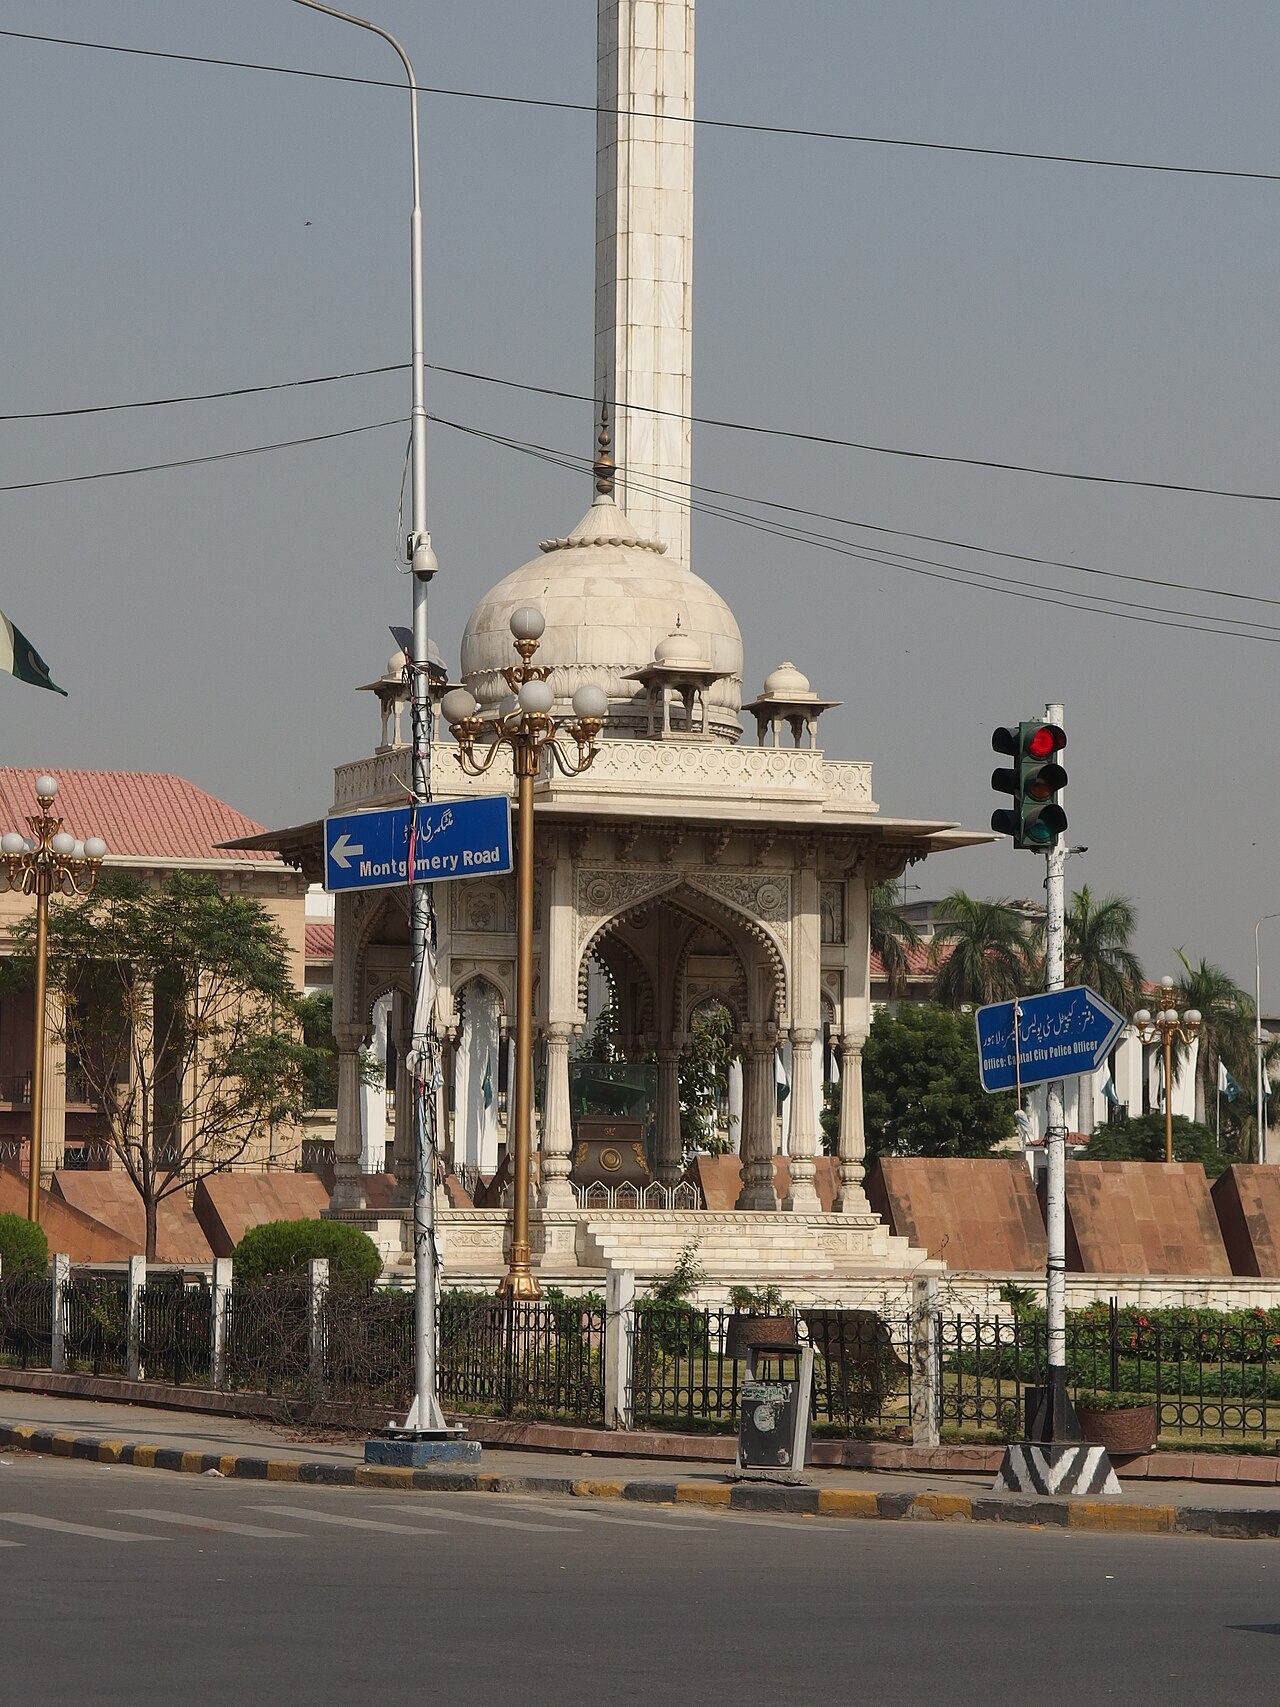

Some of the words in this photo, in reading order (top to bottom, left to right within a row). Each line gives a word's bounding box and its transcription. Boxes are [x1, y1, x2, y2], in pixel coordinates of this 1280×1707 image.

[463, 847, 500, 866] Road
[983, 1056, 1007, 1071] Office:
[1007, 1050, 1033, 1066] Caital
[1033, 1048, 1049, 1062] City
[1049, 1044, 1072, 1059] Police
[1073, 1040, 1098, 1054] Officer
